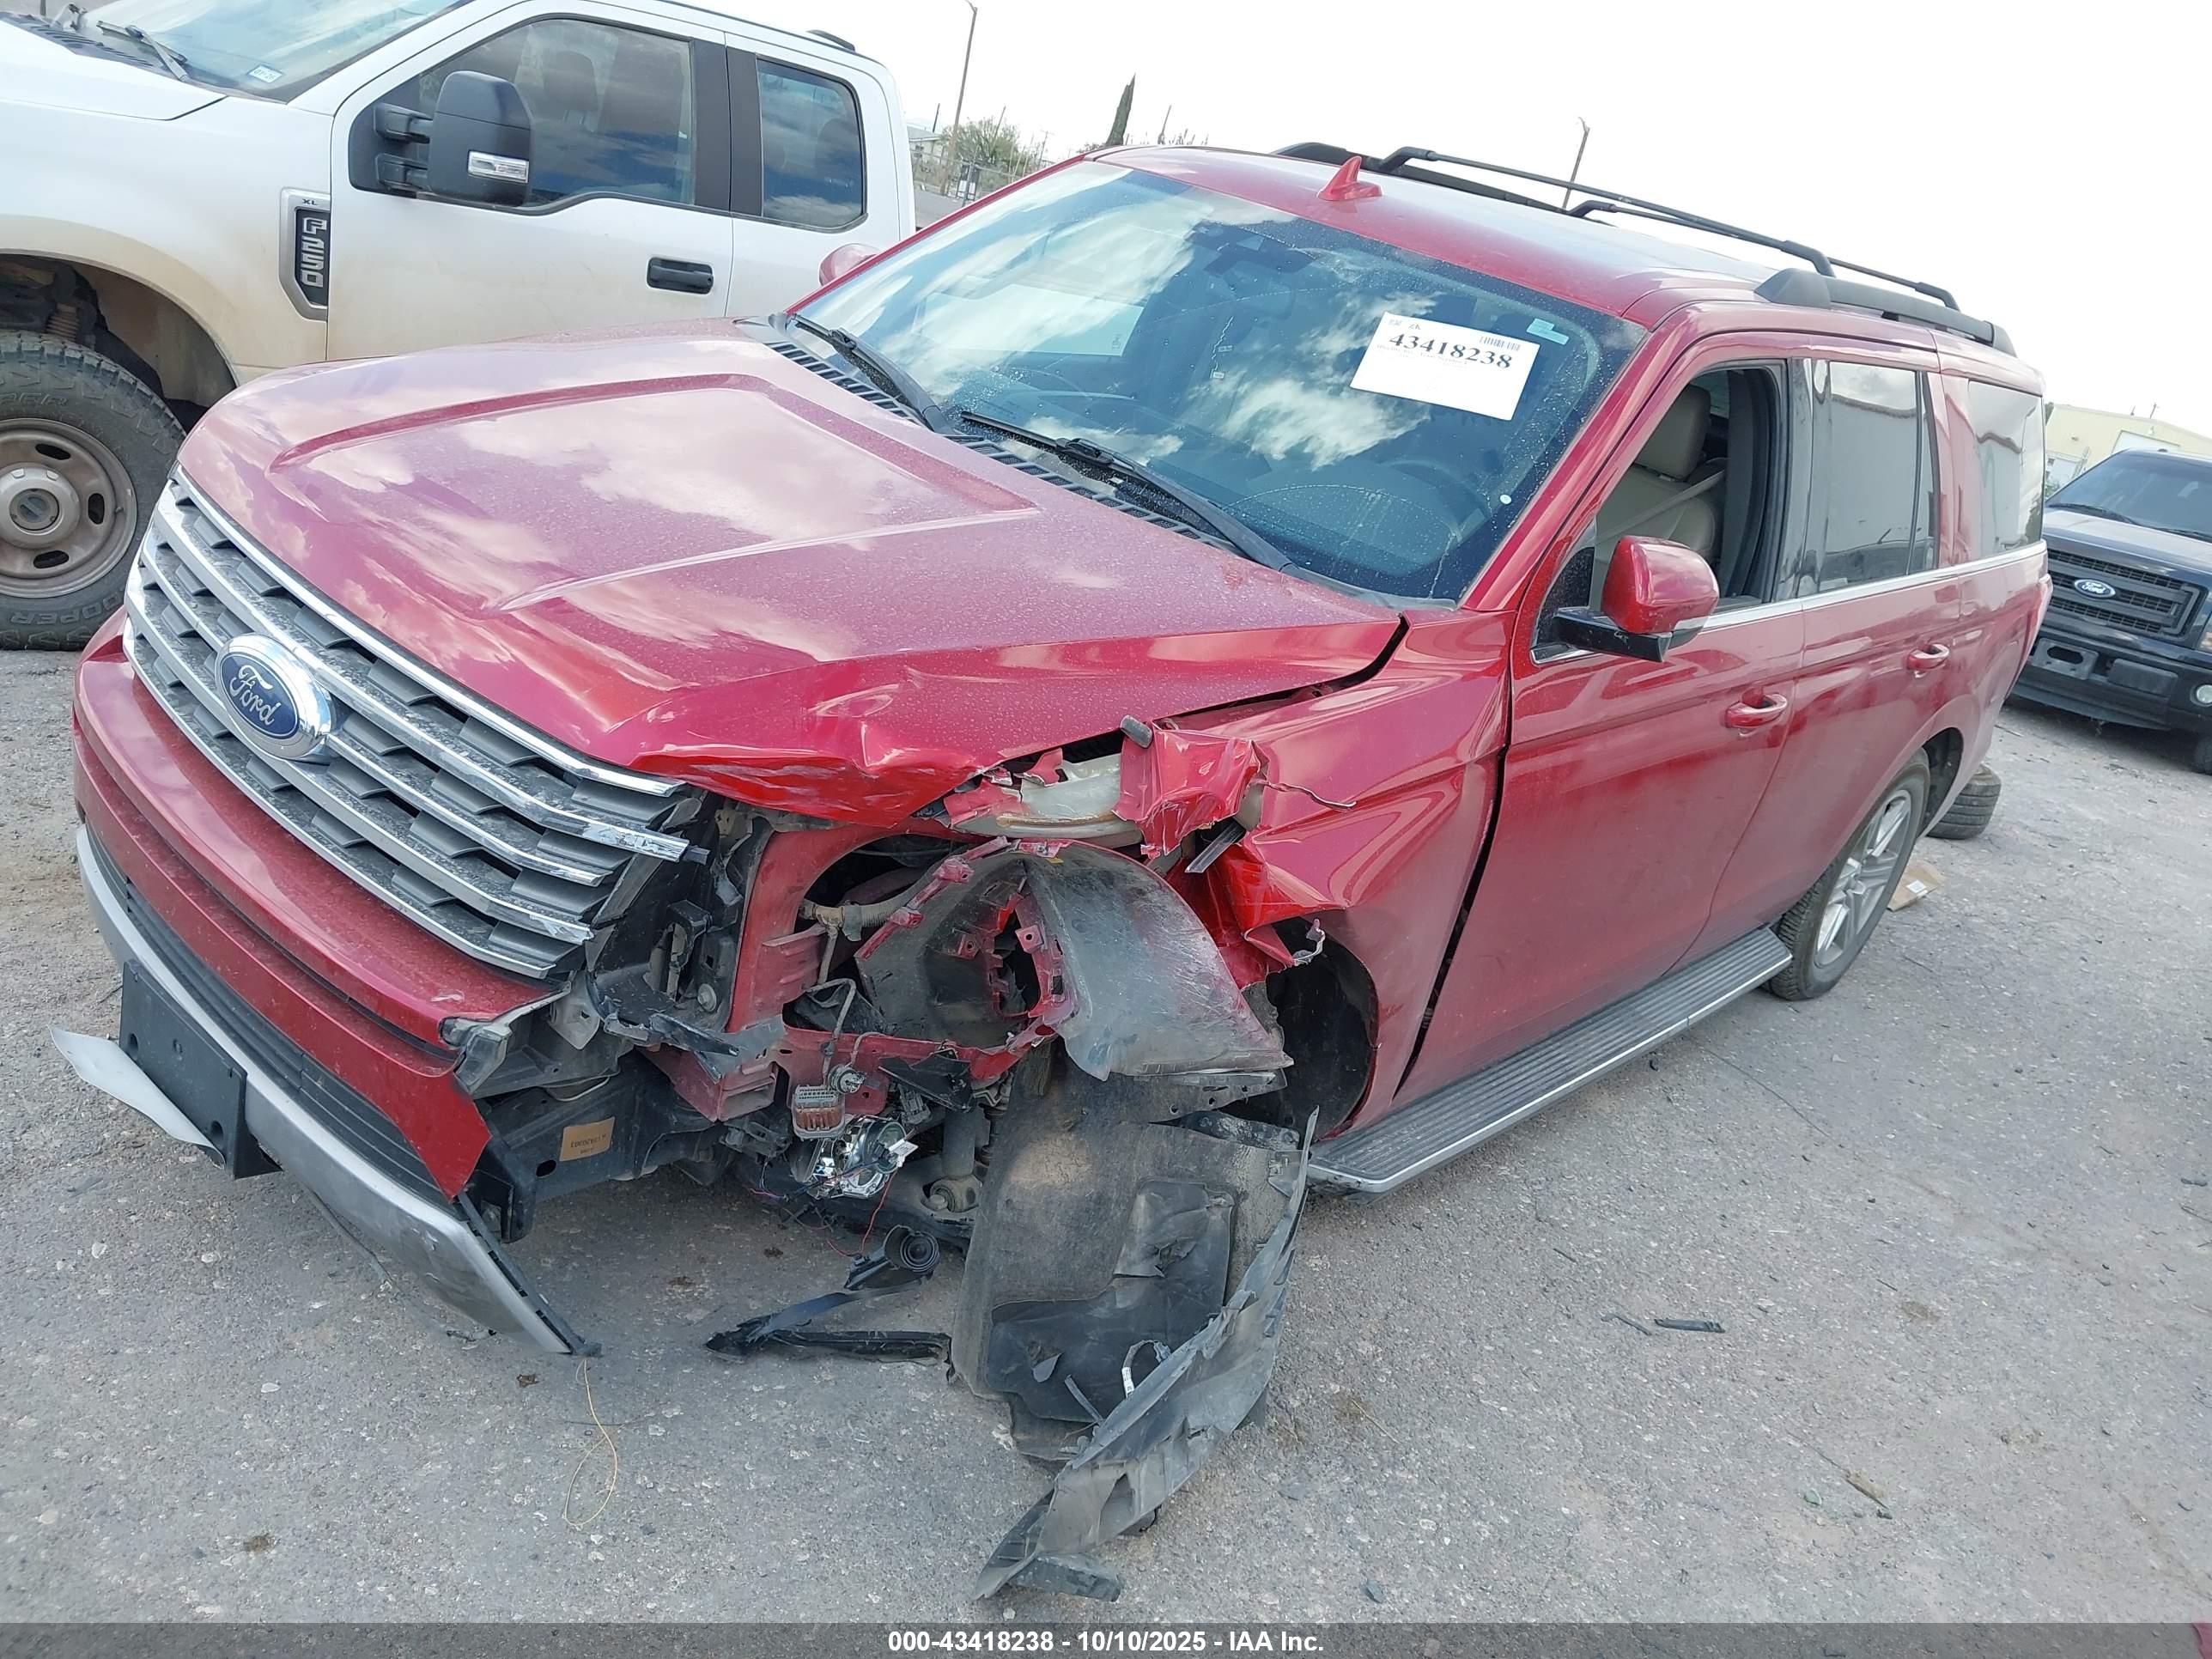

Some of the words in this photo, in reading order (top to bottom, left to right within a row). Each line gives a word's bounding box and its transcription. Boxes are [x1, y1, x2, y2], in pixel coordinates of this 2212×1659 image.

[1389, 333, 1513, 369] 43418238
[2081, 581, 2106, 593] Ford
[10, 590, 123, 625] OOPER
[229, 665, 282, 726] Ford
